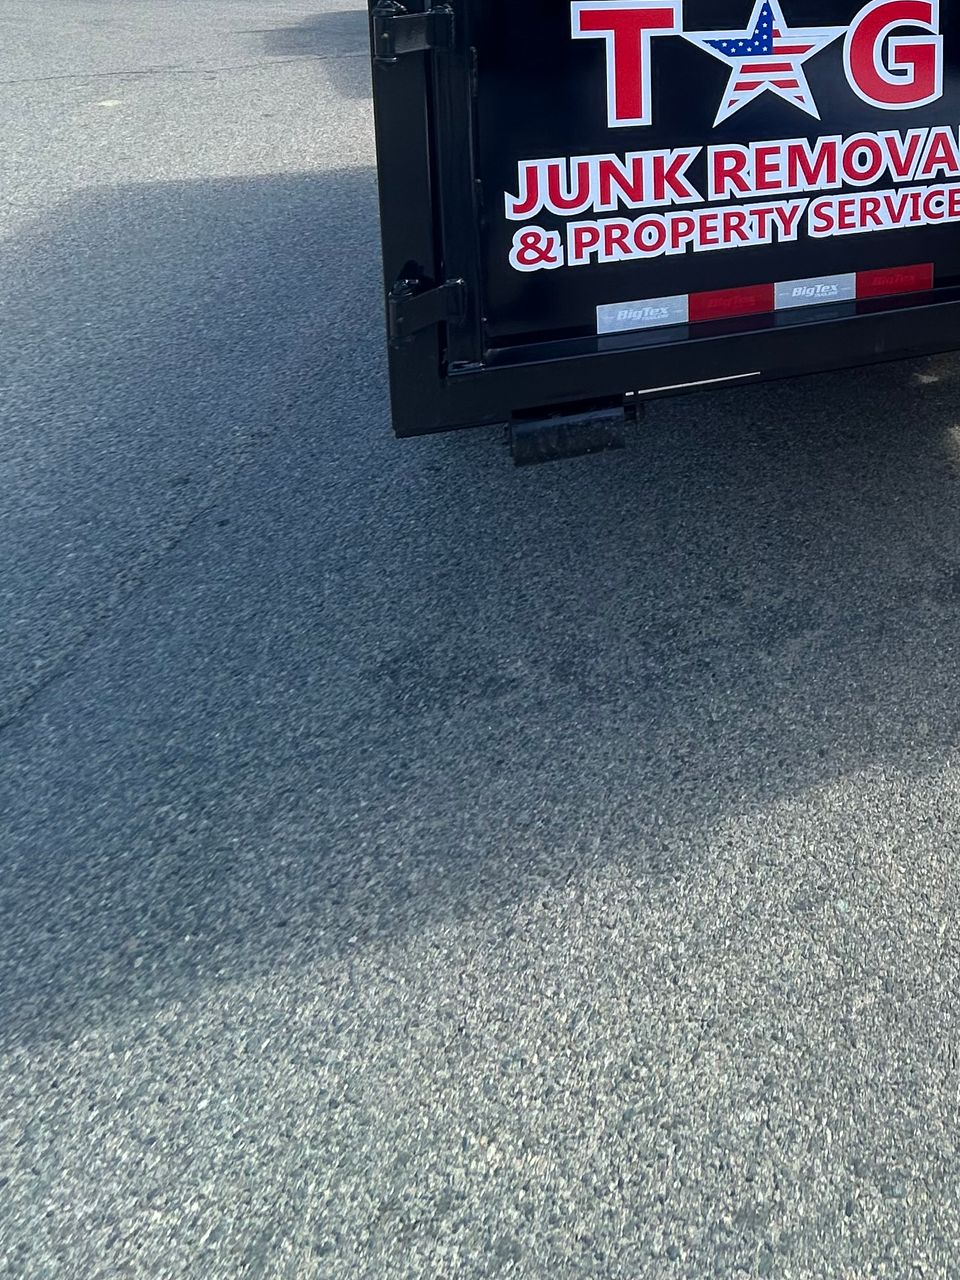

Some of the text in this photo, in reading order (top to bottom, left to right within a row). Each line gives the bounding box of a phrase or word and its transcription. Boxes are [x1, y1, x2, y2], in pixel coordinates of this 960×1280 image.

[504, 147, 704, 220] JUNK
[509, 225, 565, 272] &
[567, 198, 809, 266] PROPERTY
